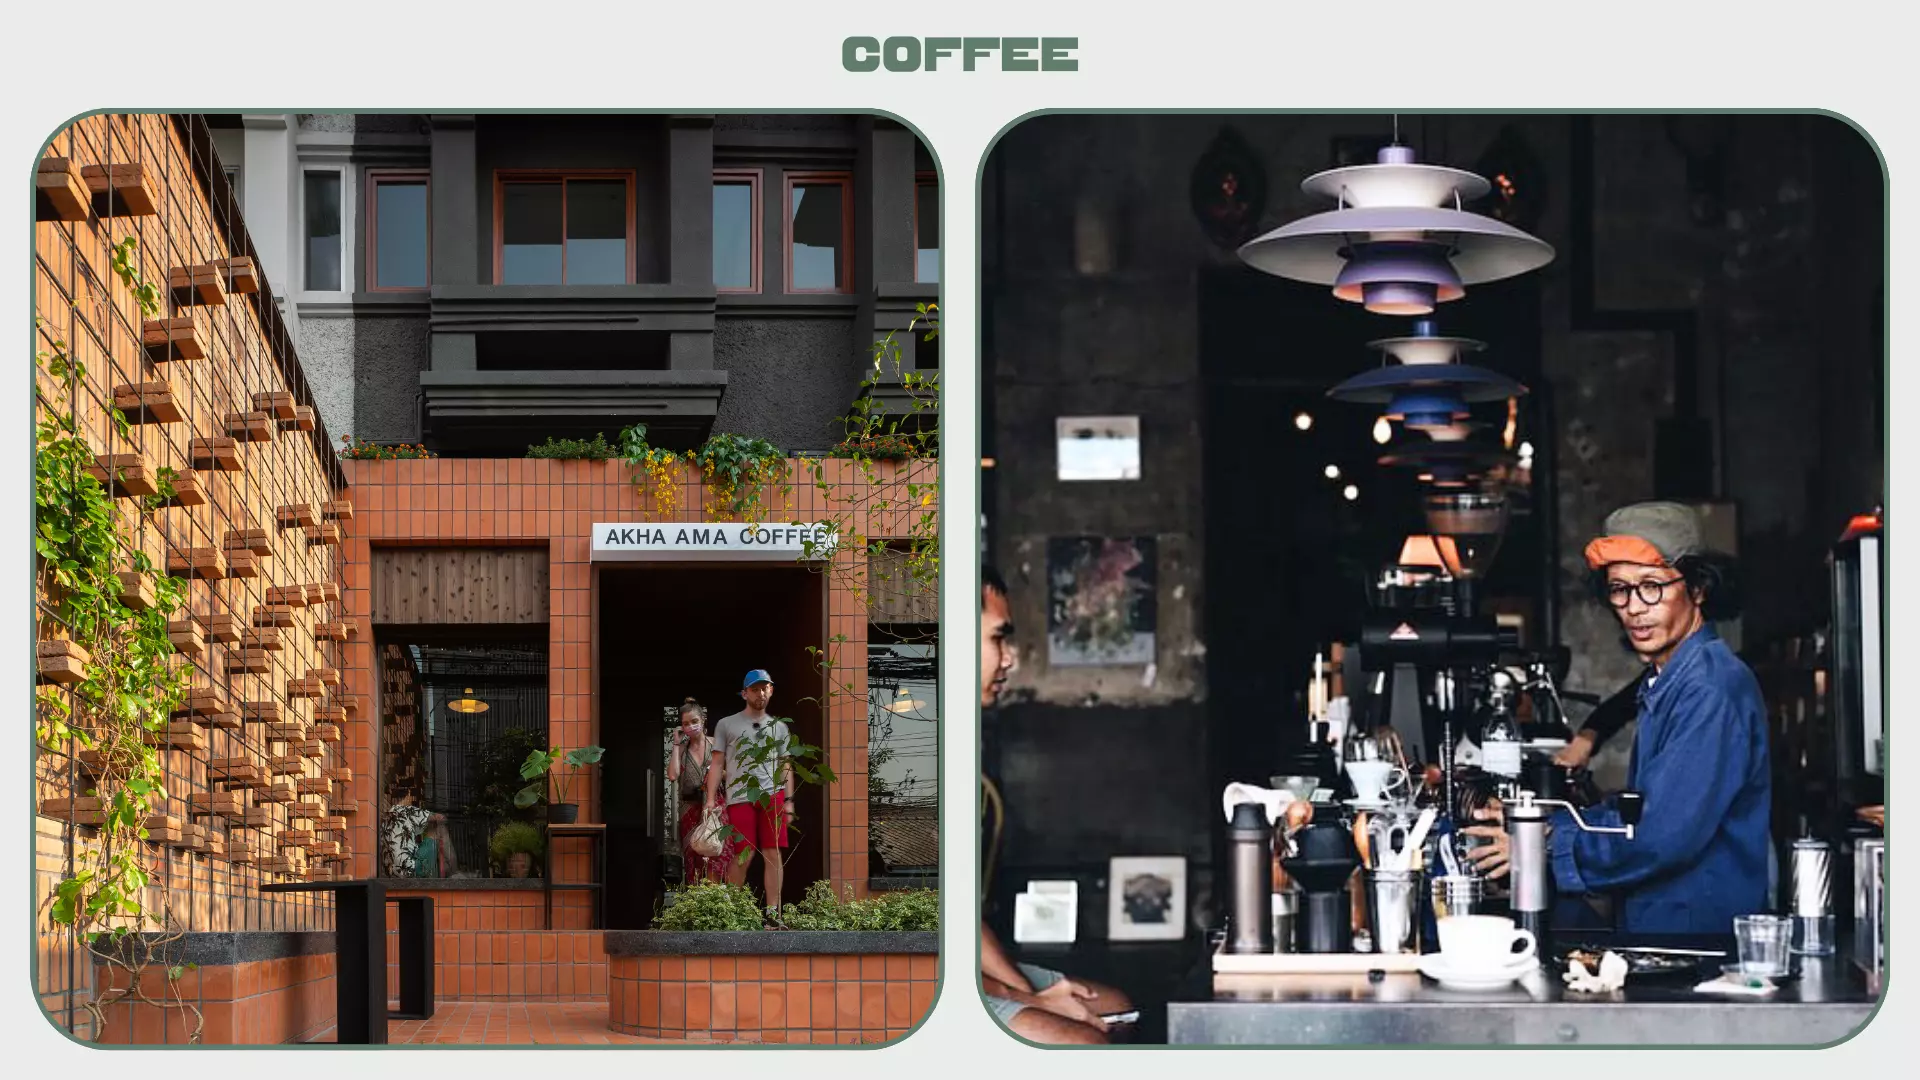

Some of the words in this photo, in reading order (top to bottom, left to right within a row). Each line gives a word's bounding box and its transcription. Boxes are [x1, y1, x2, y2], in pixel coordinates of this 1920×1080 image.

[605, 528, 667, 545] AKHA
[675, 528, 728, 545] AMA
[739, 528, 827, 545] COFFEE
